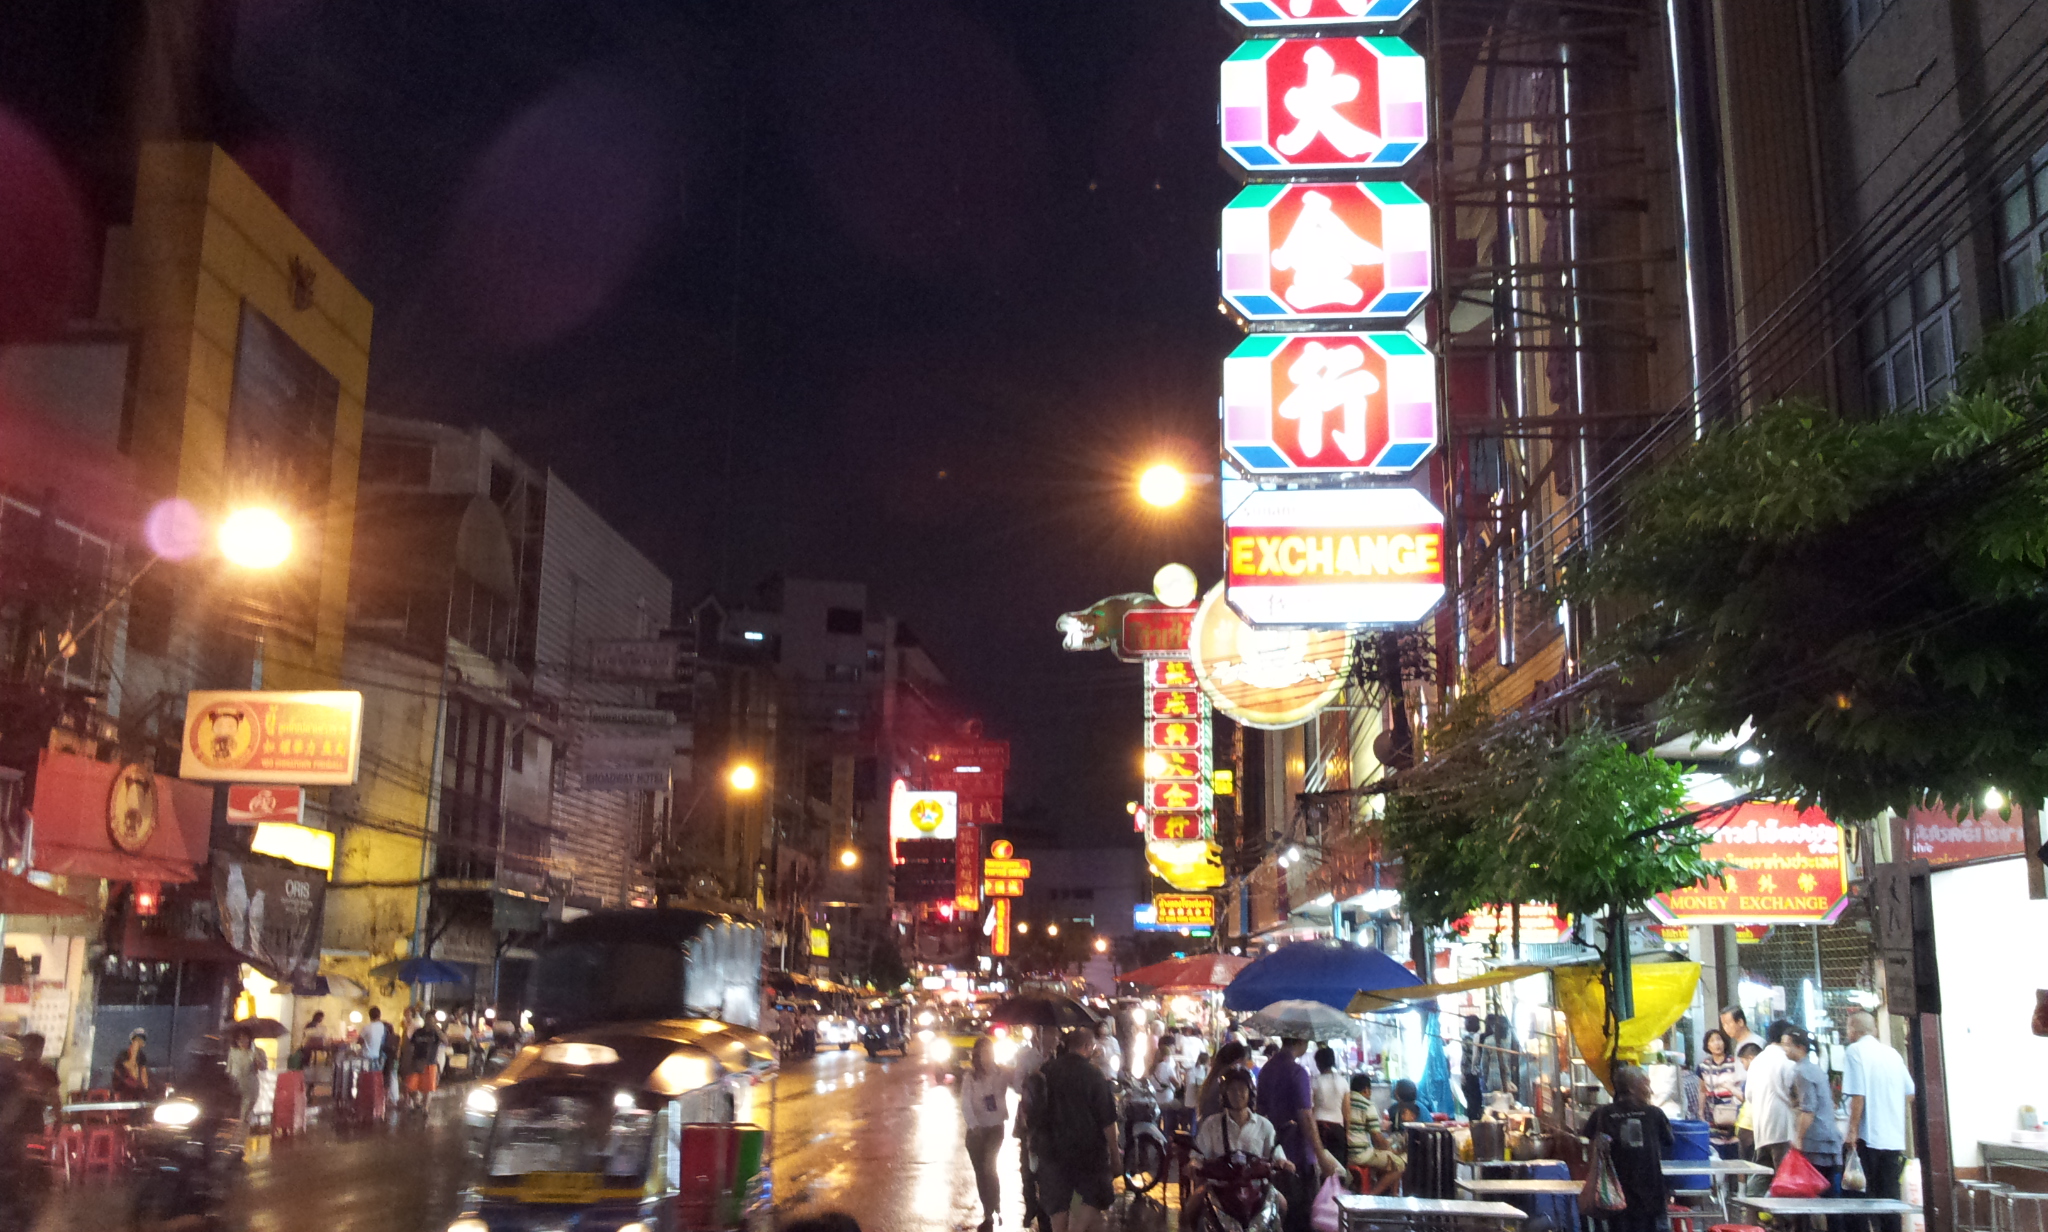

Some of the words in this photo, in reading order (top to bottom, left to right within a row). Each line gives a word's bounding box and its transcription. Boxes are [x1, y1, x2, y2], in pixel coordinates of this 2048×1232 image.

[1272, 0, 1384, 462] 大金行
[1232, 534, 1440, 576] EXCHANGE
[586, 772, 634, 784] BROADWAY
[636, 772, 663, 784] HOTEL
[285, 879, 310, 899] ORIS
[1670, 896, 1729, 910] MONEY
[1739, 896, 1828, 910] EXCHANGE
